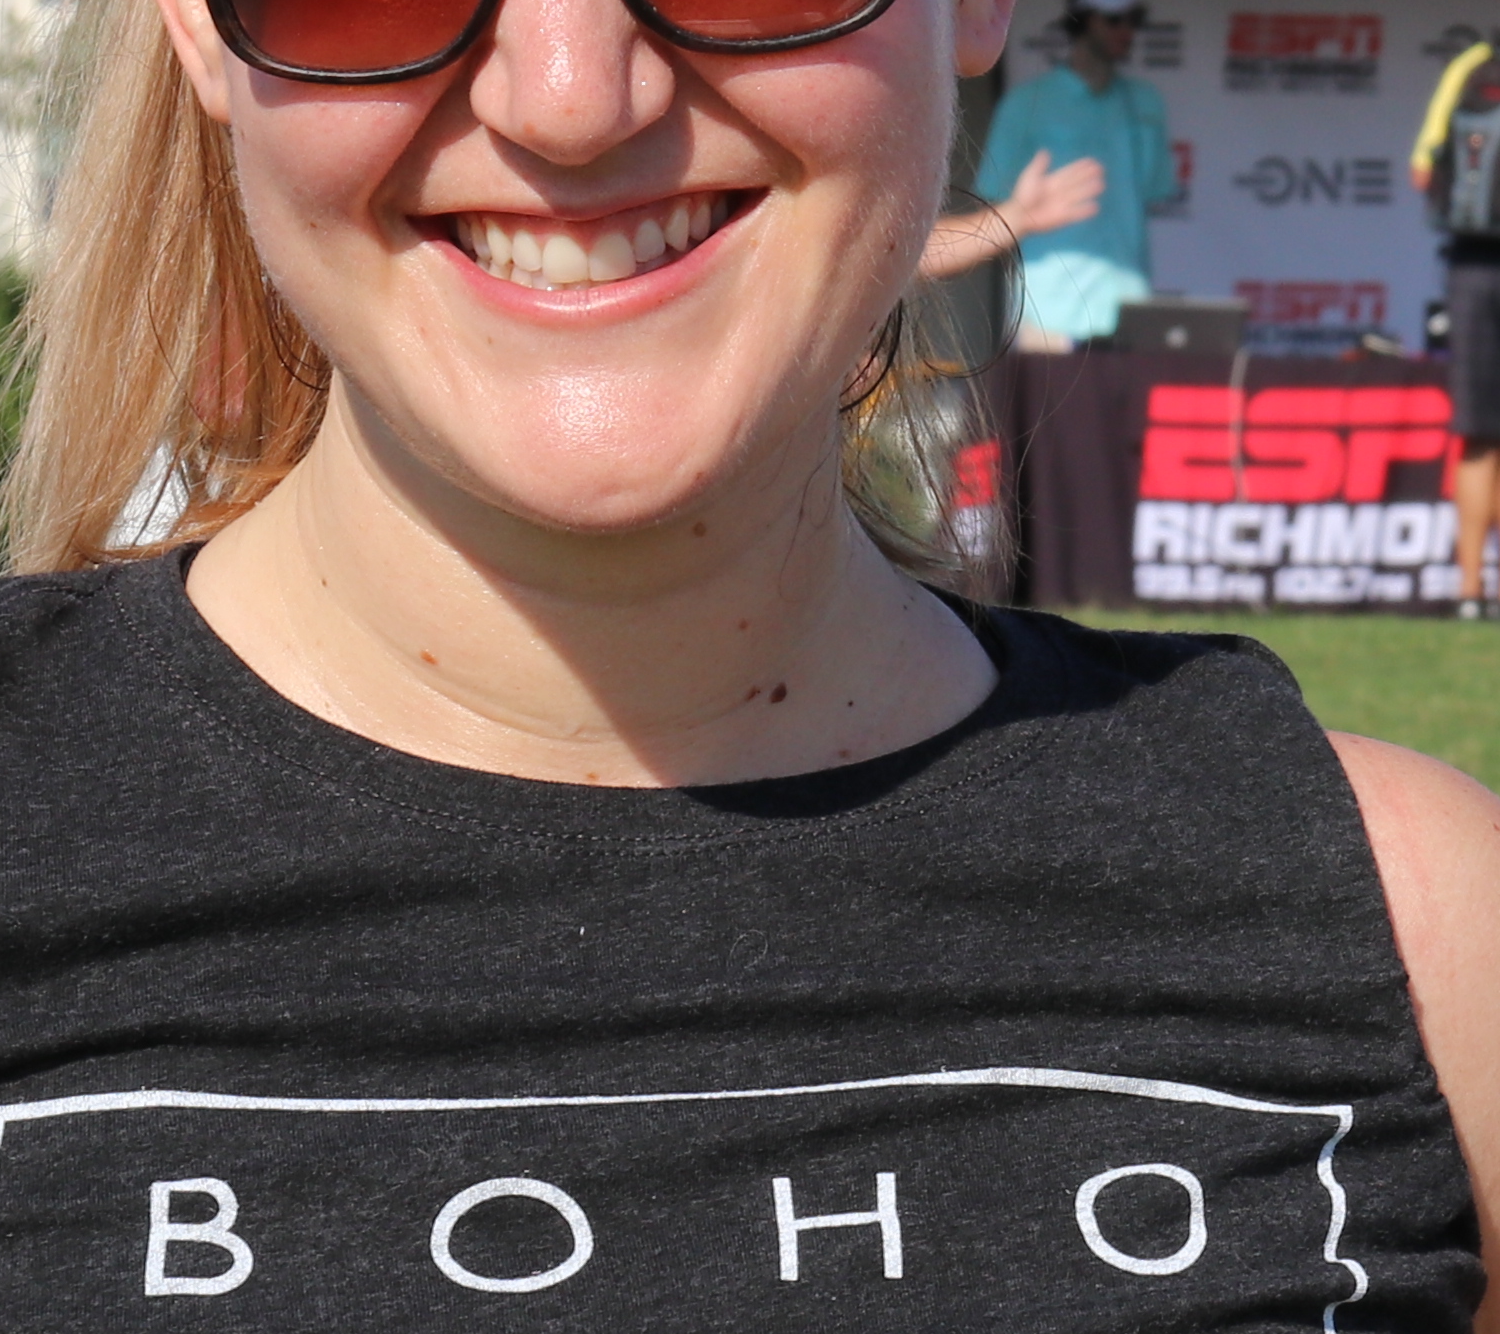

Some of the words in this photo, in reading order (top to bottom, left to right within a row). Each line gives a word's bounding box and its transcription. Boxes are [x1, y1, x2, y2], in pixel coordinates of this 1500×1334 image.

[1227, 11, 1384, 58] ESPN
[1233, 154, 1393, 206] ONE
[1132, 500, 1462, 566] RICHMO
[141, 1162, 1209, 1298] BOHO
